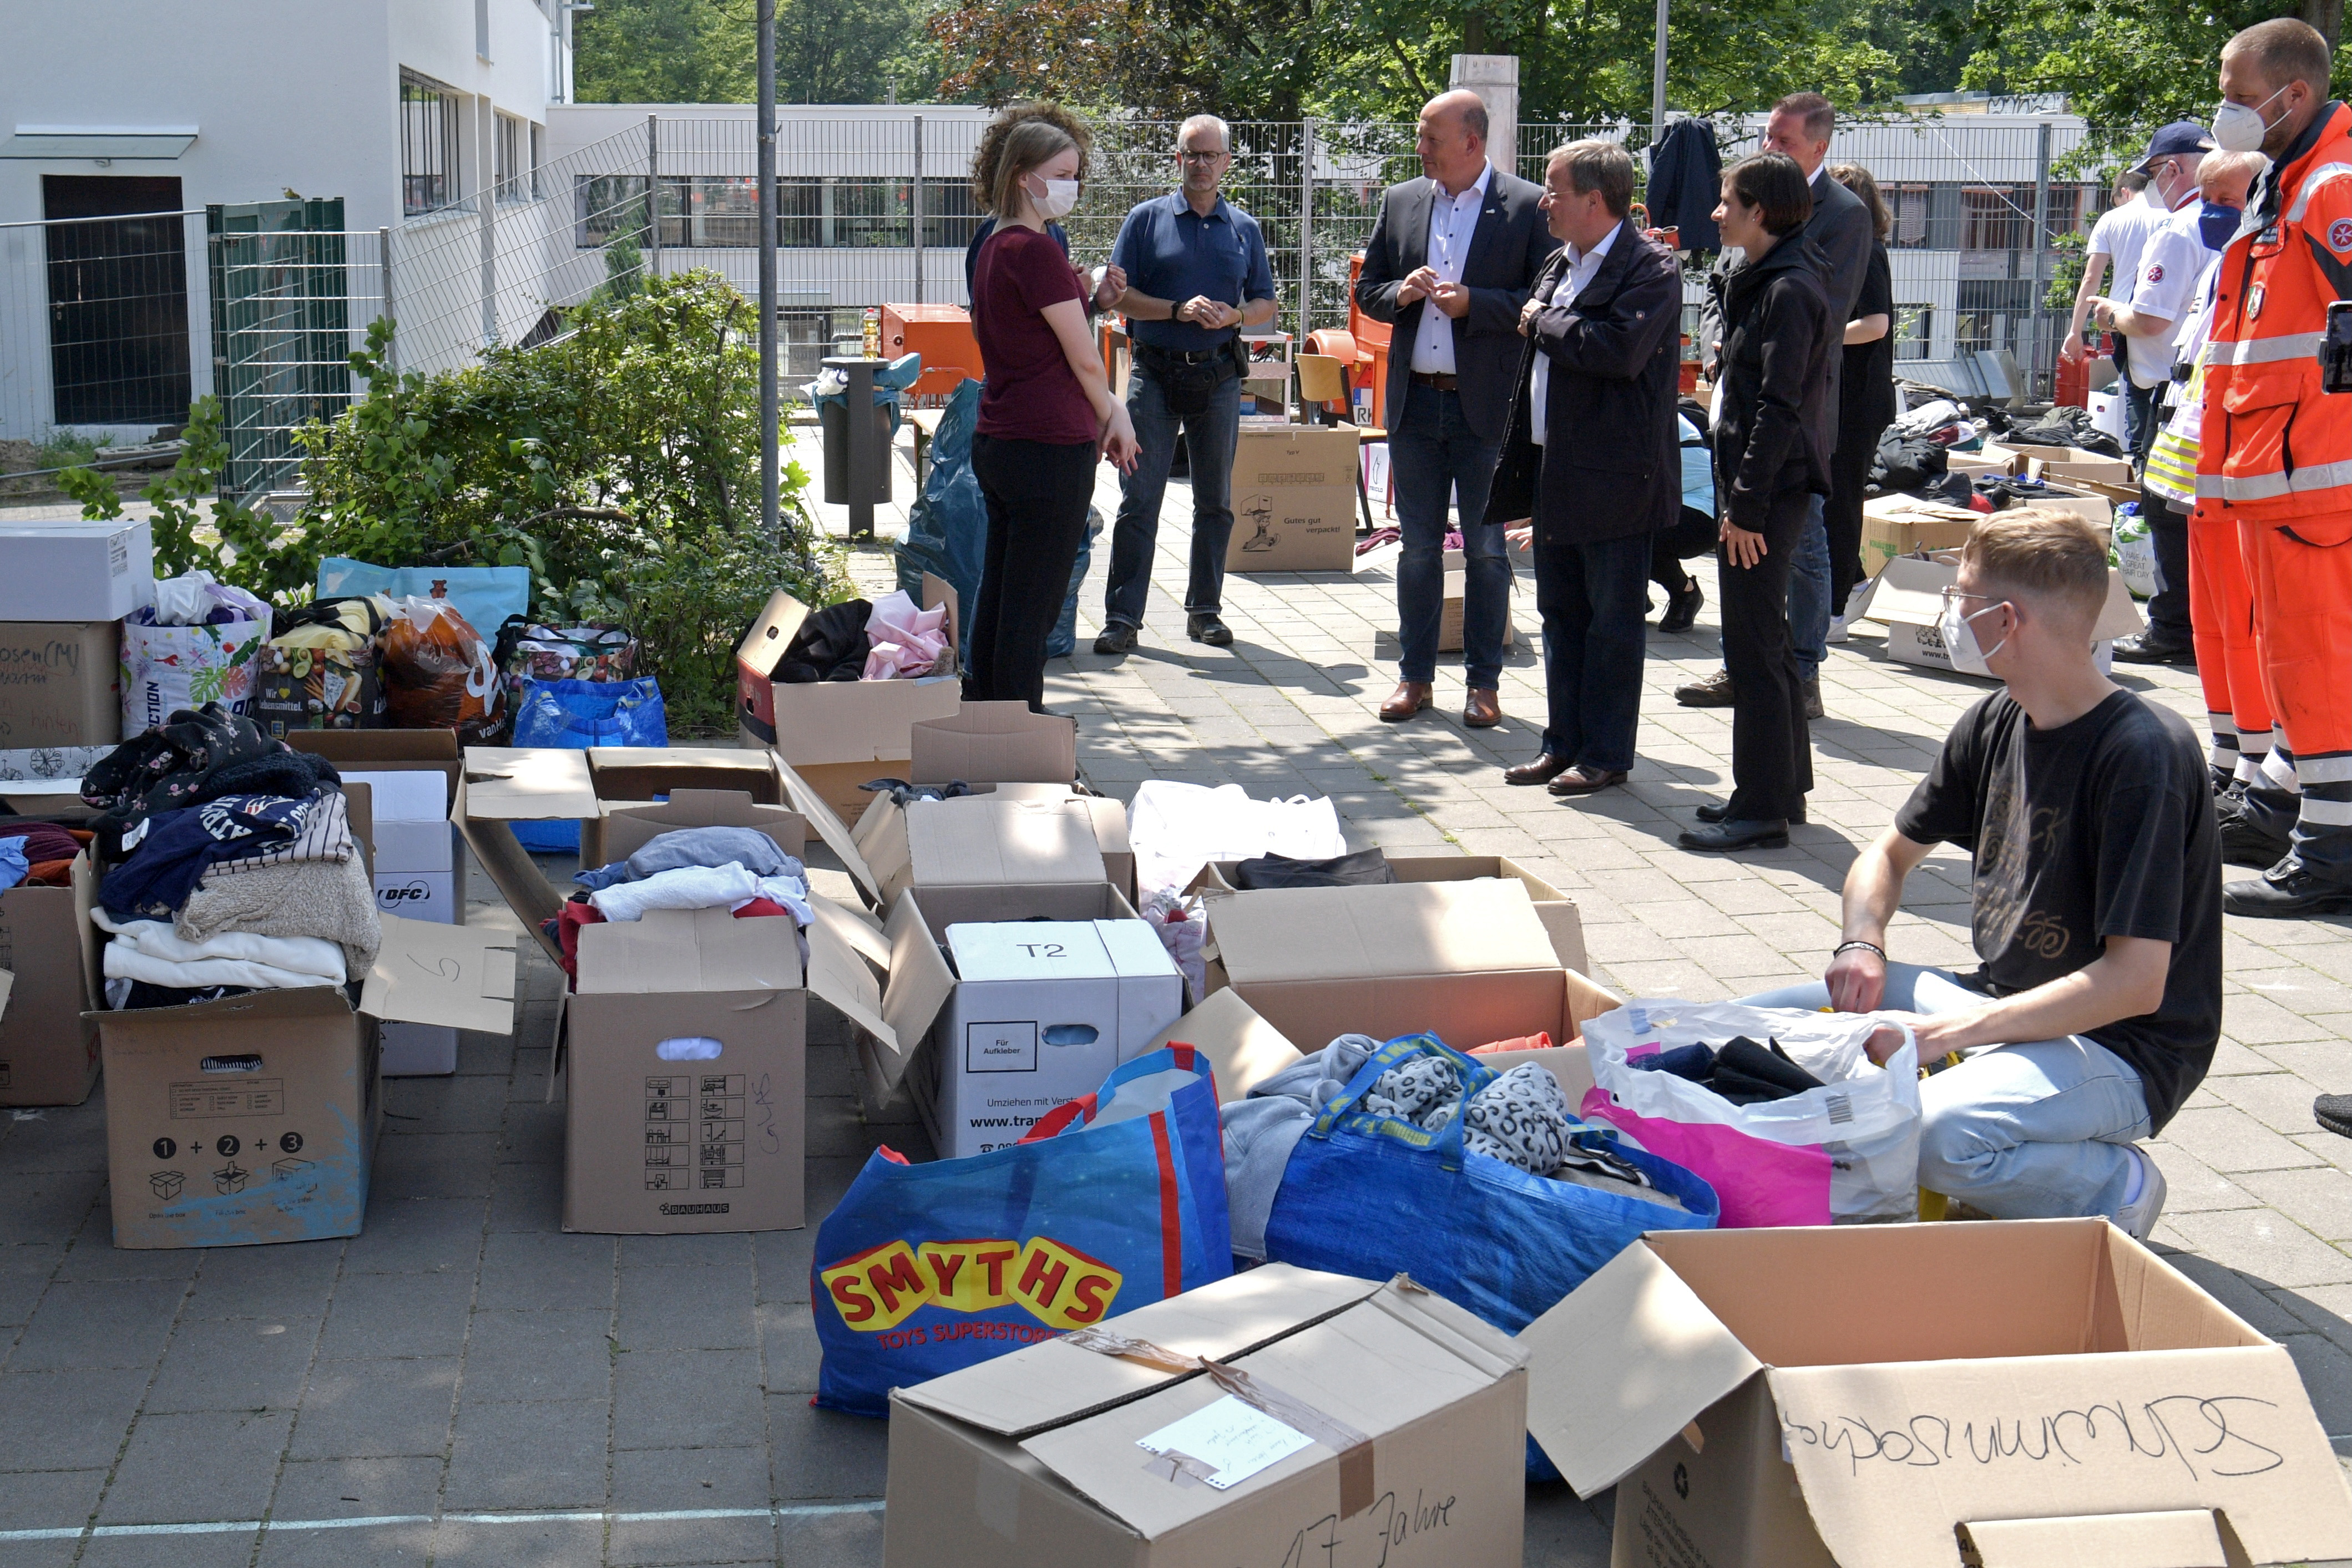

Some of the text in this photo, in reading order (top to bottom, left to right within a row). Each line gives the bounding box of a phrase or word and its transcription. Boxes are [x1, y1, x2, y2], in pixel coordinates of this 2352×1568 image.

[2126, 551, 2139, 561] HAVE
[2126, 560, 2145, 569] GREAT
[2123, 568, 2136, 576] HAIR
[266, 688, 277, 699] Wir
[146, 681, 160, 727] CTION
[259, 700, 303, 711] Lebensmittel.
[1016, 944, 1067, 957] T2
[987, 1096, 1078, 1107] Umziehen mit Verst
[223, 1138, 234, 1154] 2
[287, 1135, 297, 1150] 3
[670, 1203, 729, 1215] BAUHAUS
[831, 1248, 1113, 1323] SMYTHS
[876, 1327, 927, 1350] TOYS
[1368, 1489, 1456, 1568] Jahre
